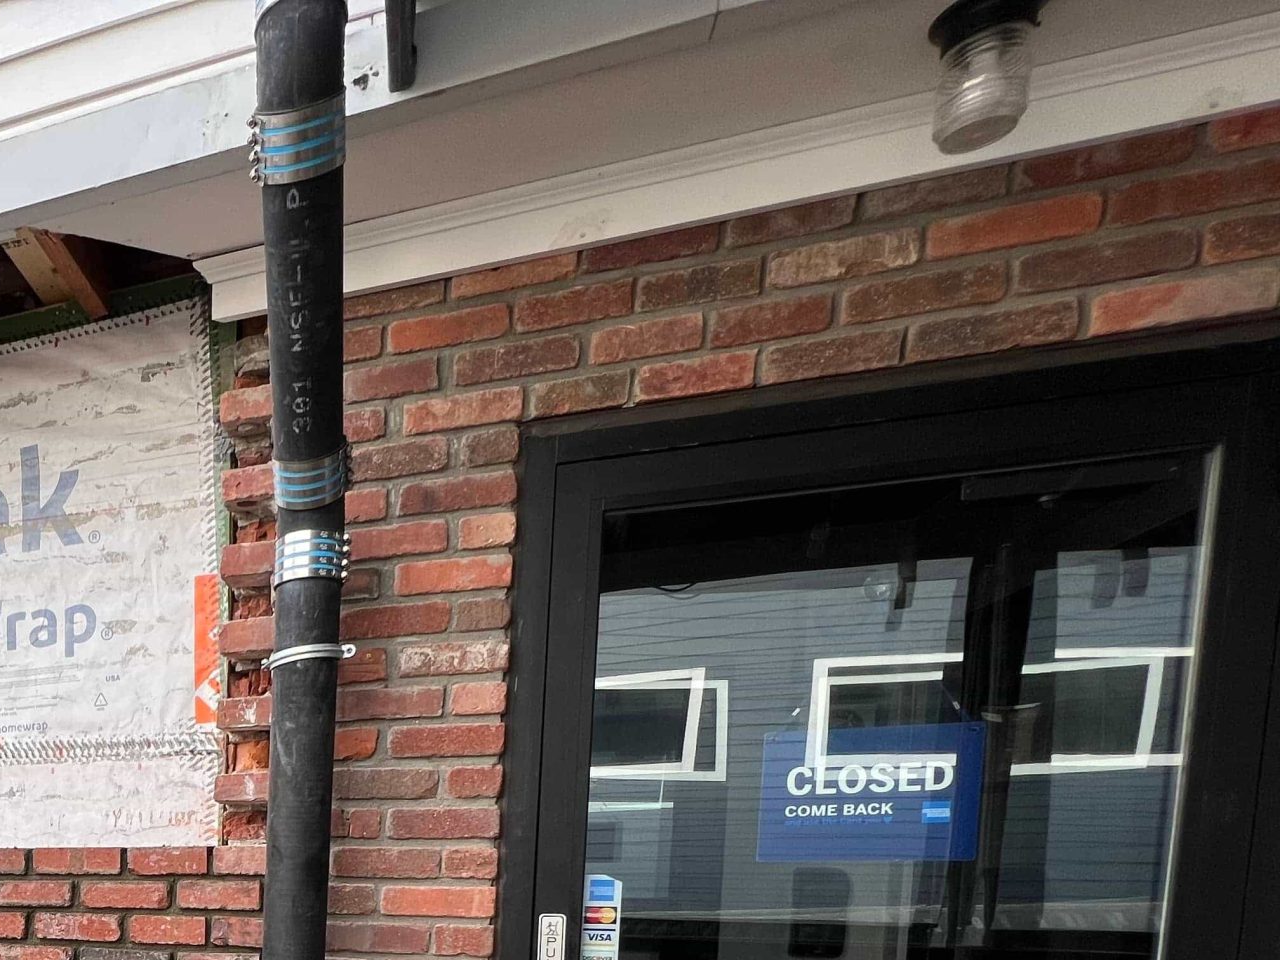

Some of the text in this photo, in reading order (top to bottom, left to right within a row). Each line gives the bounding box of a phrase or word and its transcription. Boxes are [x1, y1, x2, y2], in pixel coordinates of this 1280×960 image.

[786, 760, 955, 796] CLOSED
[784, 802, 894, 818] COME BACK
[587, 932, 612, 942] VISA
